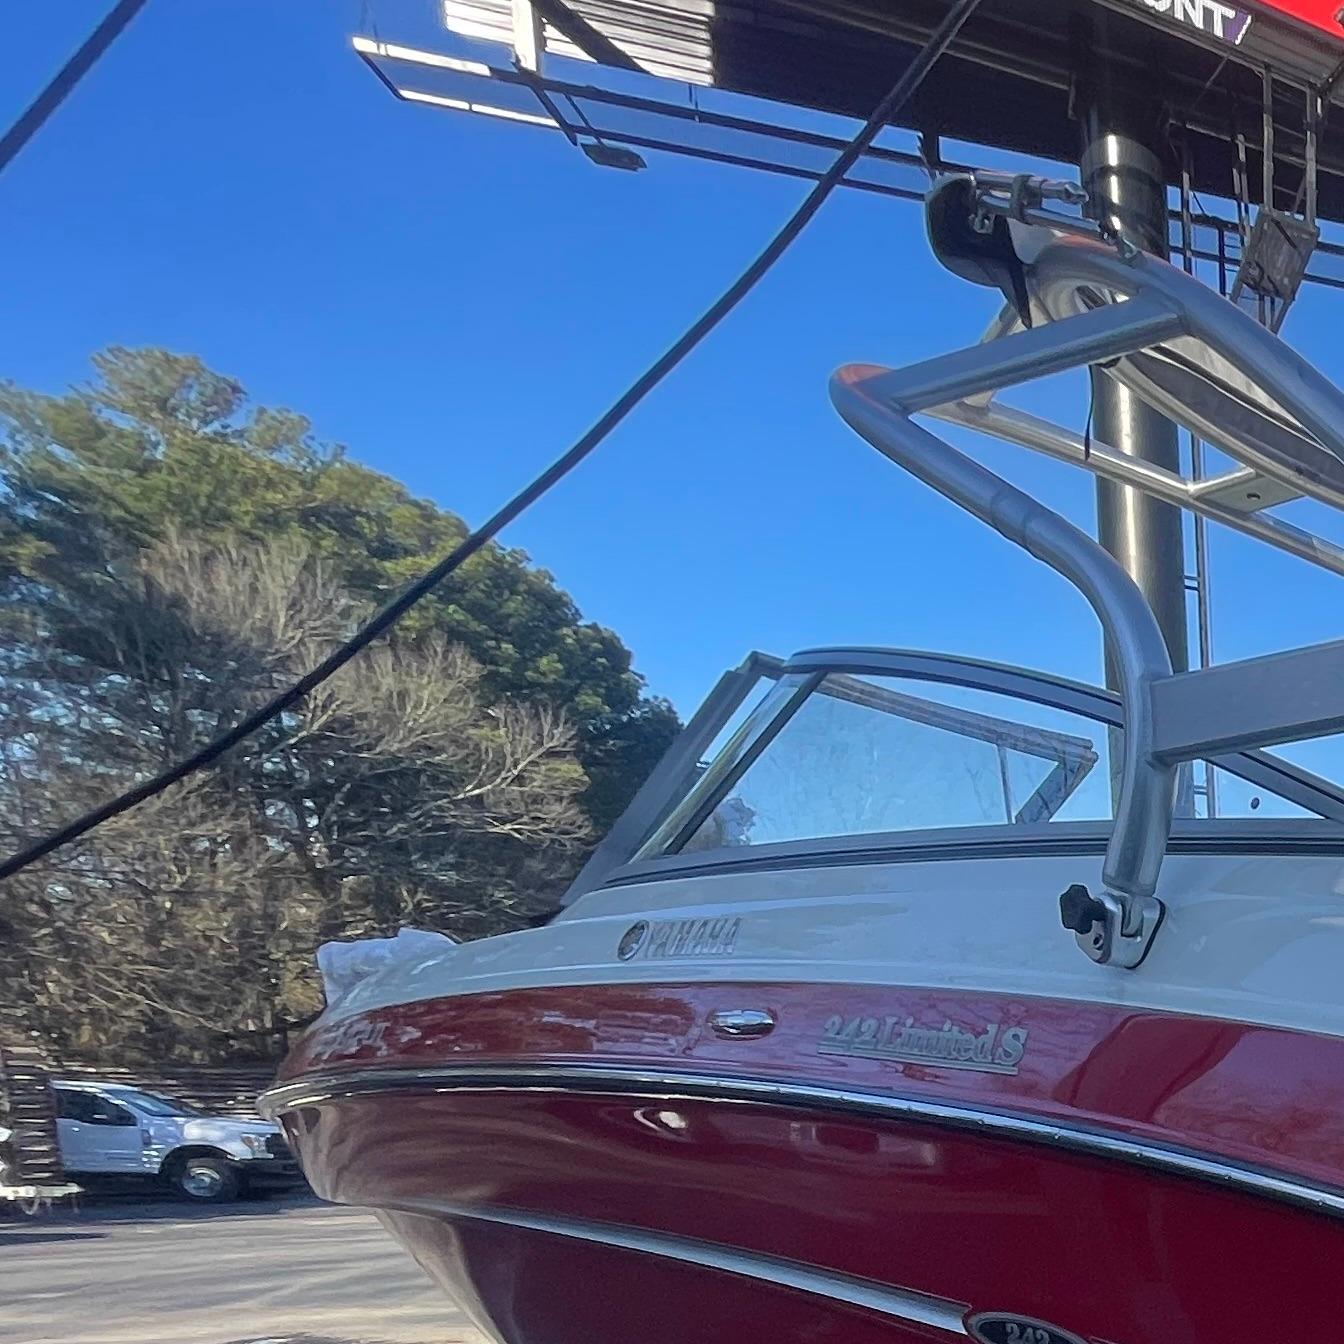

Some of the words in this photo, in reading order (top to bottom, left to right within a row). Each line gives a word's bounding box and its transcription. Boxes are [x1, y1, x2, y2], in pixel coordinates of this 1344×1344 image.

[822, 1014, 881, 1044] 242
[878, 1015, 998, 1063] Limited
[997, 1026, 1029, 1067] S
